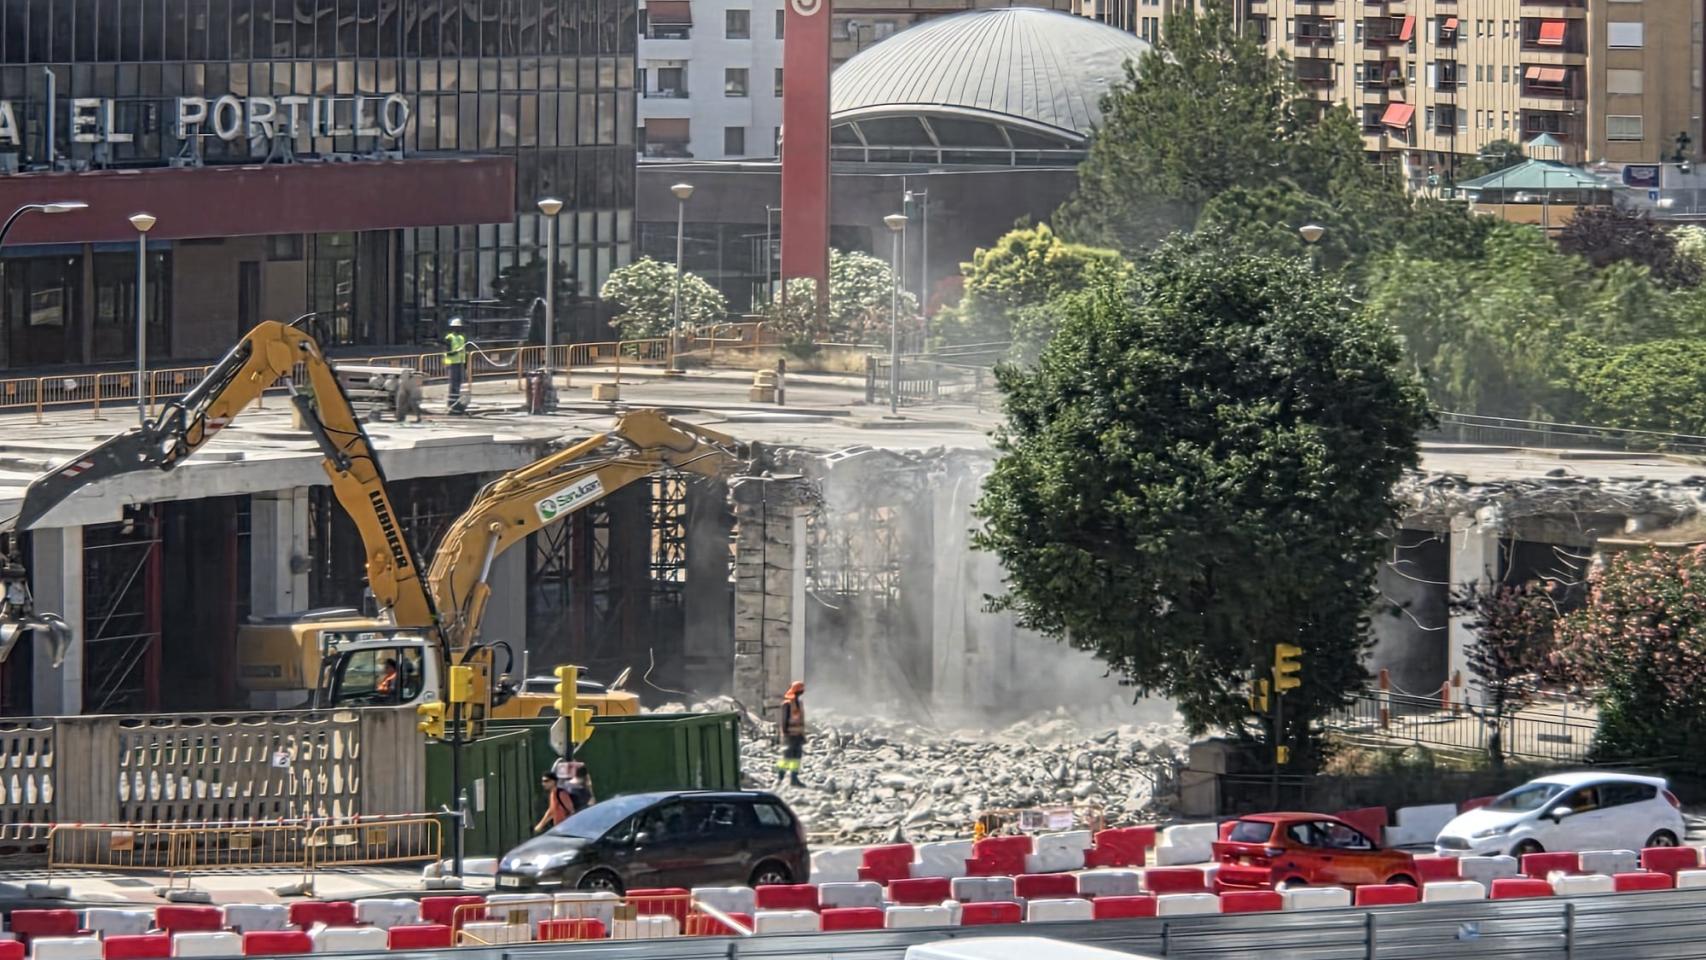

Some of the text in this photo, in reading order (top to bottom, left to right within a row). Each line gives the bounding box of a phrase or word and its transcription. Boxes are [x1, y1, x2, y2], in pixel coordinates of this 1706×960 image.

[72, 98, 133, 142] EL
[178, 94, 411, 140] PORTILLO
[369, 489, 408, 569] LIEBHERR
